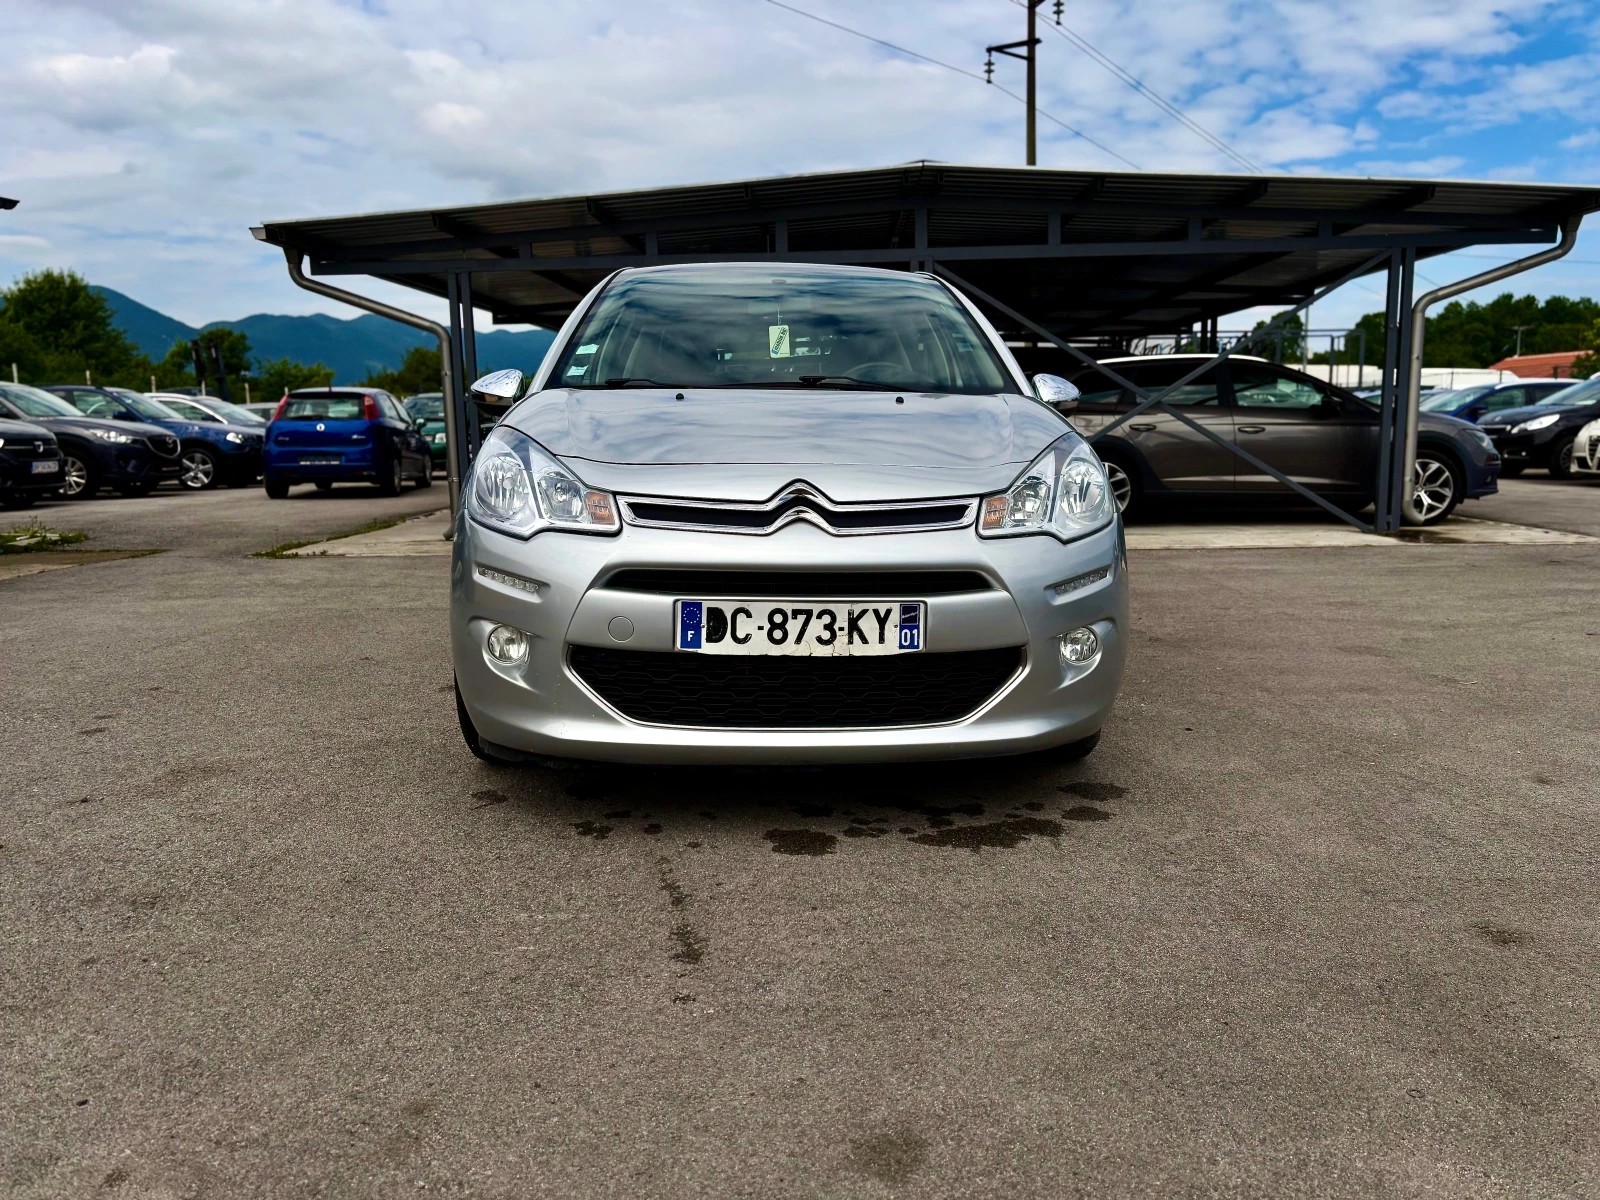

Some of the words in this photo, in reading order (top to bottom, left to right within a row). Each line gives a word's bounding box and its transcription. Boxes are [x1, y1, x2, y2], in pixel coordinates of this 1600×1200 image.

[705, 606, 892, 646] DC-873-KY
[687, 630, 695, 642] F
[901, 628, 918, 646] 01
